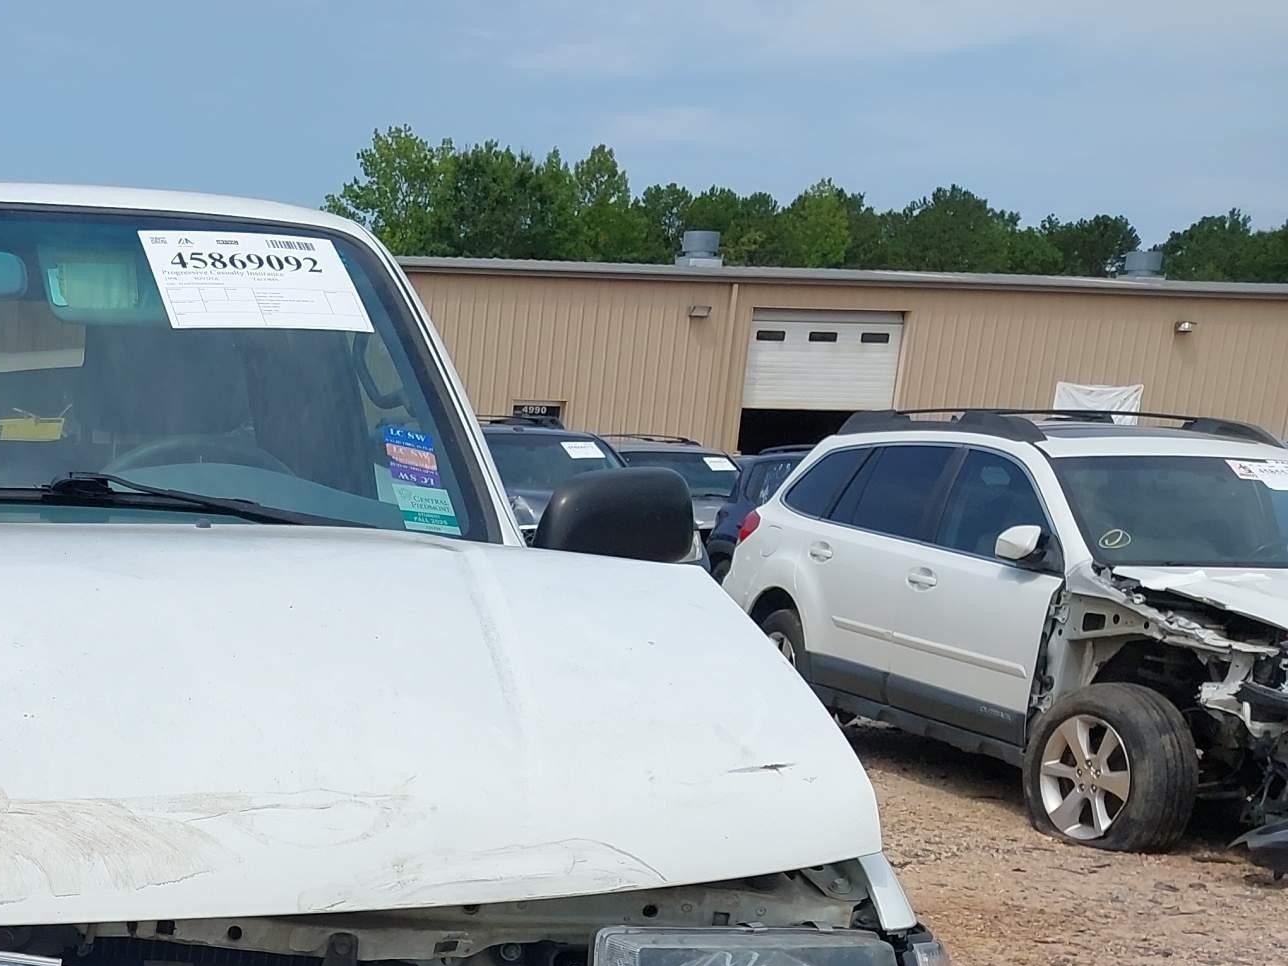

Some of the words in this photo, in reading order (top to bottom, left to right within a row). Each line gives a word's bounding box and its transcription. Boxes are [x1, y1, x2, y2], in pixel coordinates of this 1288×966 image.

[170, 252, 323, 273] 45869092
[162, 269, 208, 277] Progressive
[210, 269, 244, 277] Casualty
[521, 406, 547, 414] 4990
[413, 495, 450, 505] CENTRAL
[411, 501, 450, 513] PIEDMONT
[414, 516, 429, 524] FALL
